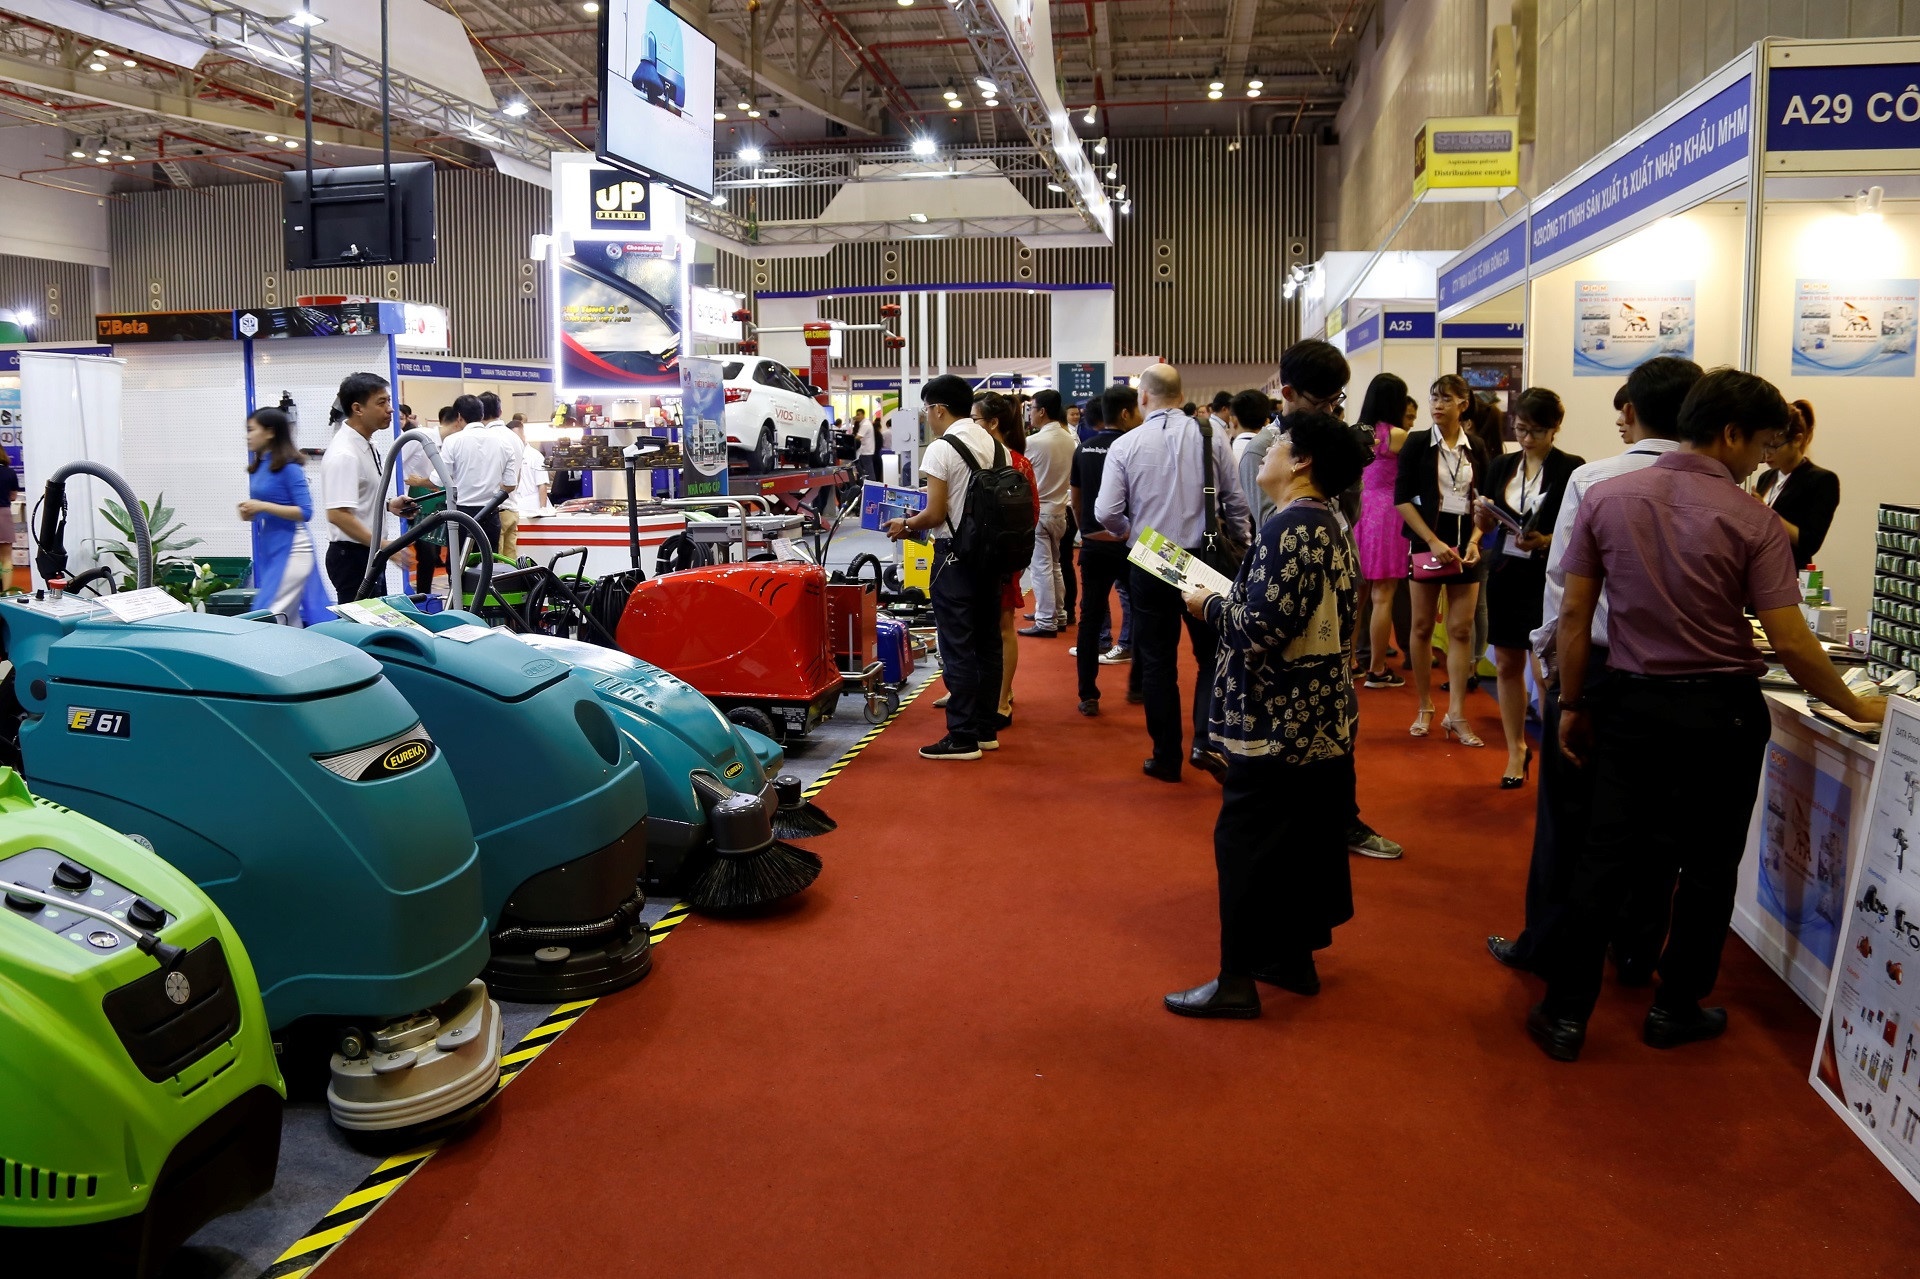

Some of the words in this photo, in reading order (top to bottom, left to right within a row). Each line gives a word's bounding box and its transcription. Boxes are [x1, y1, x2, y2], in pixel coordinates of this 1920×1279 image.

[1781, 94, 1852, 125] A29
[1434, 169, 1483, 177] Distribuzione
[1484, 168, 1511, 177] energia
[1560, 214, 1568, 231] TY
[1568, 205, 1585, 228] TNHH
[1586, 189, 1601, 220] SẢN
[1601, 172, 1621, 212] XUẤT
[1622, 176, 1629, 200] &
[1630, 154, 1654, 196] XUẤT
[1655, 142, 1682, 181] NHẬP
[1684, 117, 1715, 166] KHẨU
[1718, 104, 1748, 147] MHM
[595, 181, 645, 211] UP
[112, 319, 149, 335] Beta
[1388, 320, 1413, 332] A25
[775, 408, 794, 421] VIOS
[688, 481, 699, 496] NHÀ
[699, 482, 712, 494] CUNG
[71, 711, 91, 730] E
[96, 714, 123, 734] 61
[389, 745, 424, 768] EUREKA
[726, 763, 742, 777] EUREKA
